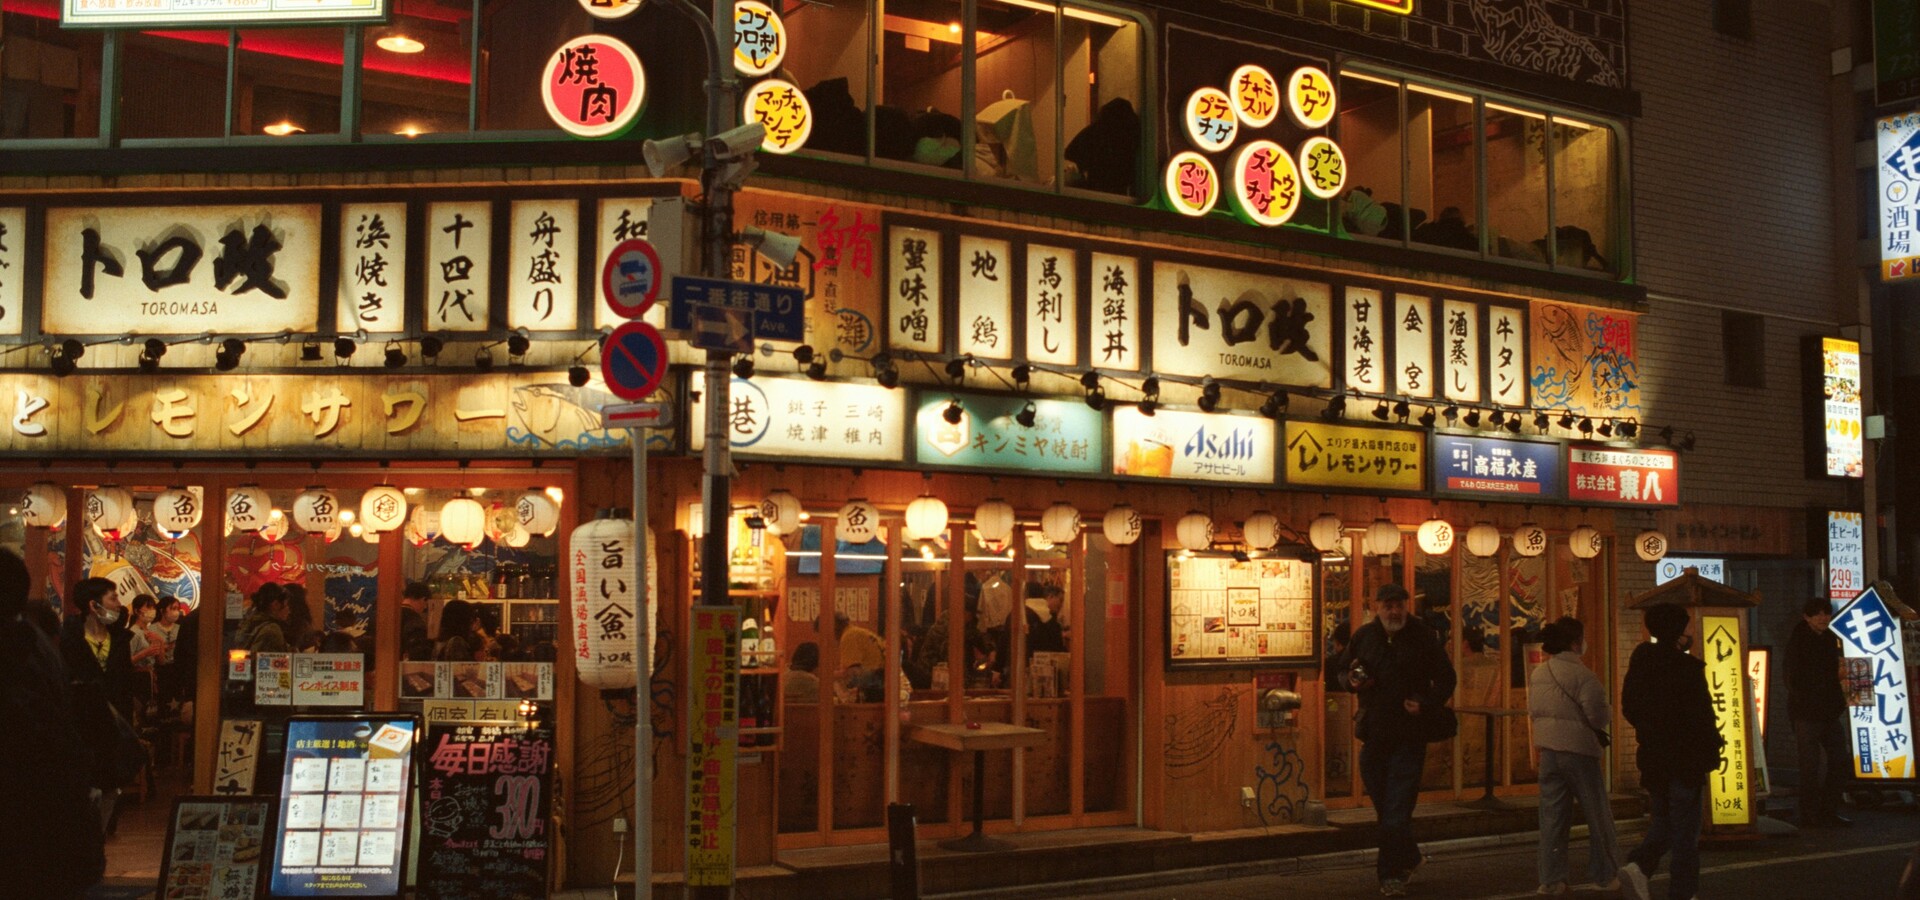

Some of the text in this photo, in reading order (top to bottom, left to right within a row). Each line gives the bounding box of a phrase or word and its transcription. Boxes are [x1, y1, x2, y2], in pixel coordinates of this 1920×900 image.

[558, 45, 618, 123] 焼肉
[1301, 74, 1331, 117] ユッケ
[1179, 162, 1209, 211] マッコリ
[754, 209, 817, 230] 信用第一
[1887, 205, 1911, 254] 酒場
[812, 207, 880, 279] 鮪
[355, 213, 391, 322] 浜焼き
[437, 213, 474, 323] 十四代
[527, 210, 562, 322] 舟盛り
[684, 285, 793, 315] 二番街通り
[900, 236, 929, 343] 蟹味噌
[970, 250, 999, 349] 地鶏
[140, 301, 218, 316] TOROMASA
[1036, 256, 1063, 354] 馬刺し
[1102, 265, 1129, 363] 海鮮丼
[760, 319, 789, 333] Ave.
[1352, 297, 1374, 384] 甘海老
[1219, 353, 1272, 370] TOROMASA
[1402, 304, 1423, 391] 金宮
[1449, 309, 1468, 393] 酒蒸し
[1495, 315, 1515, 397] 牛タン
[1599, 368, 1613, 410] 大漁
[786, 399, 828, 418] 銚子
[786, 423, 883, 446] 焼津 稚内
[972, 432, 1089, 461] キンミヤ焼酎
[1184, 424, 1254, 461] Asahi
[1193, 461, 1246, 476] アサヒビール
[1326, 452, 1417, 475] レモンサワー
[1474, 454, 1537, 479] 高福水産
[1611, 454, 1666, 468] まぐろのことなら
[1576, 474, 1617, 492] 株式会社
[171, 494, 195, 524] 魚
[231, 493, 256, 522] 魚
[309, 494, 333, 523] 魚
[846, 506, 869, 534] 魚
[1433, 525, 1450, 548] 魚
[1526, 529, 1543, 551] 魚
[1829, 521, 1860, 540] 生ビール
[1830, 542, 1861, 553] レモンサワー
[1831, 555, 1859, 566] ハイボール
[600, 539, 628, 641] 旨い魚
[298, 680, 360, 692] インボイス制度
[1845, 607, 1908, 751] もんじゃ
[429, 732, 552, 778] 毎日感謝
[429, 777, 445, 800] 本日
